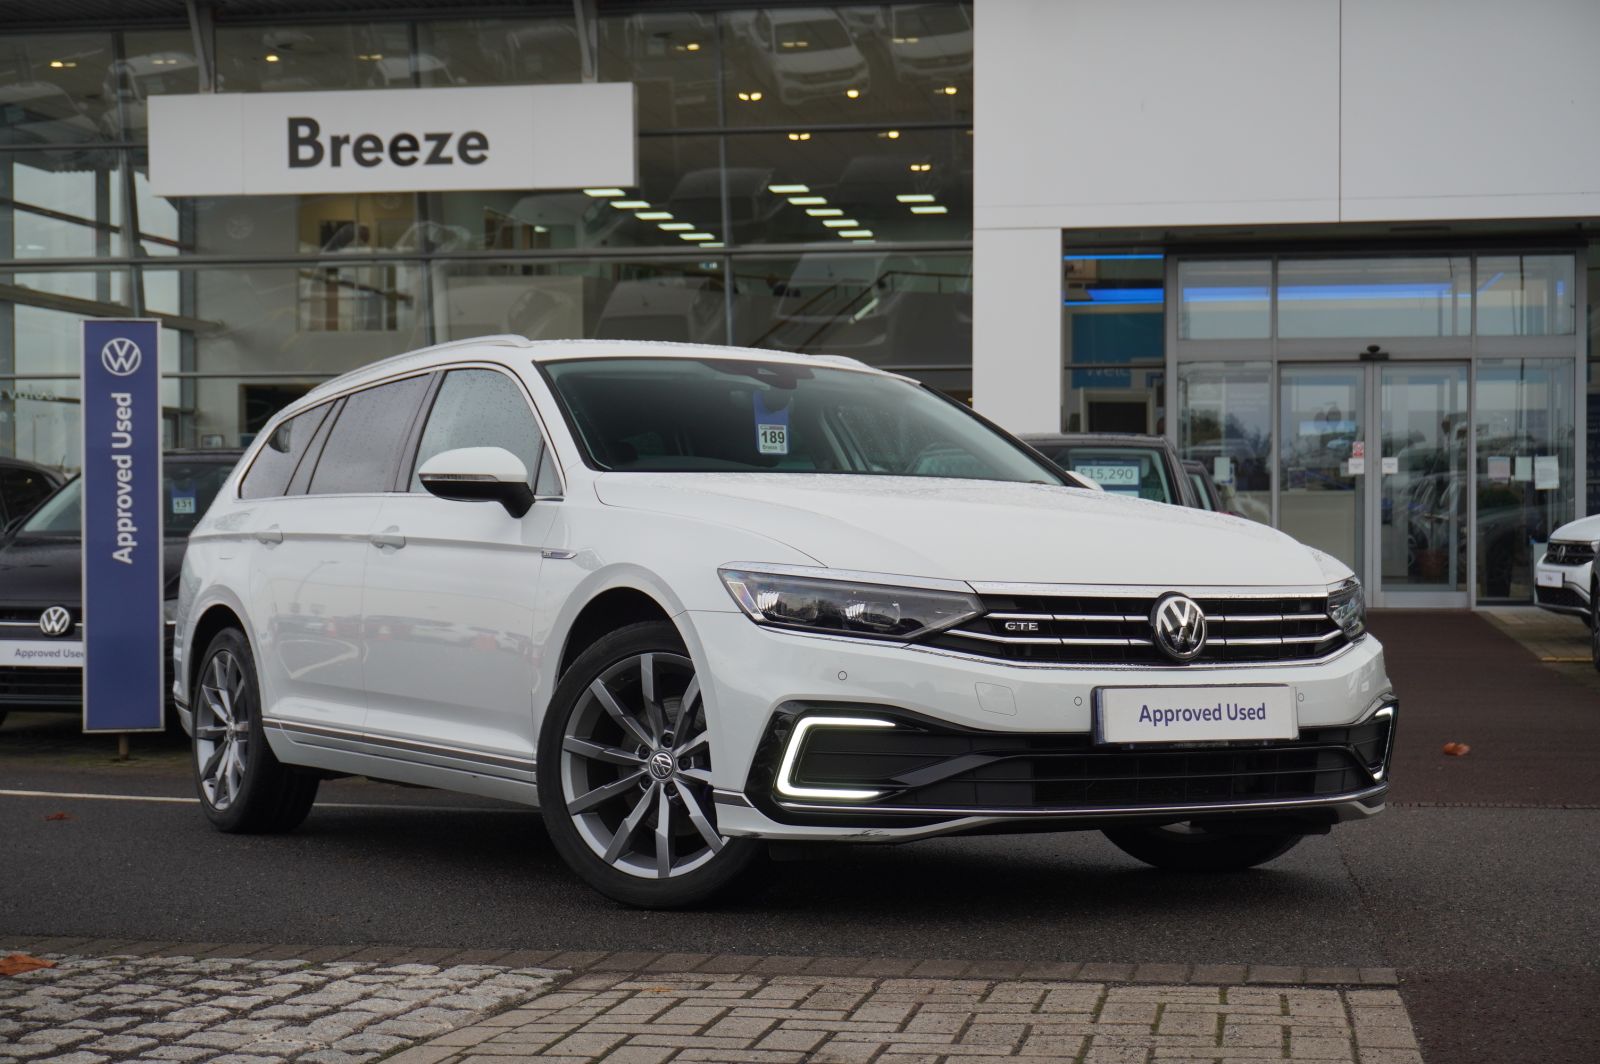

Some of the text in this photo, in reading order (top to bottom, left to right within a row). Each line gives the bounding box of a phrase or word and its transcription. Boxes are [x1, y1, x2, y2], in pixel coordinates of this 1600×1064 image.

[287, 116, 489, 169] Breeze
[761, 431, 785, 444] 189
[111, 392, 138, 564] Approved Used
[1004, 621, 1039, 631] GTE
[14, 648, 61, 658] Approved
[1139, 702, 1266, 727] Approved Used
